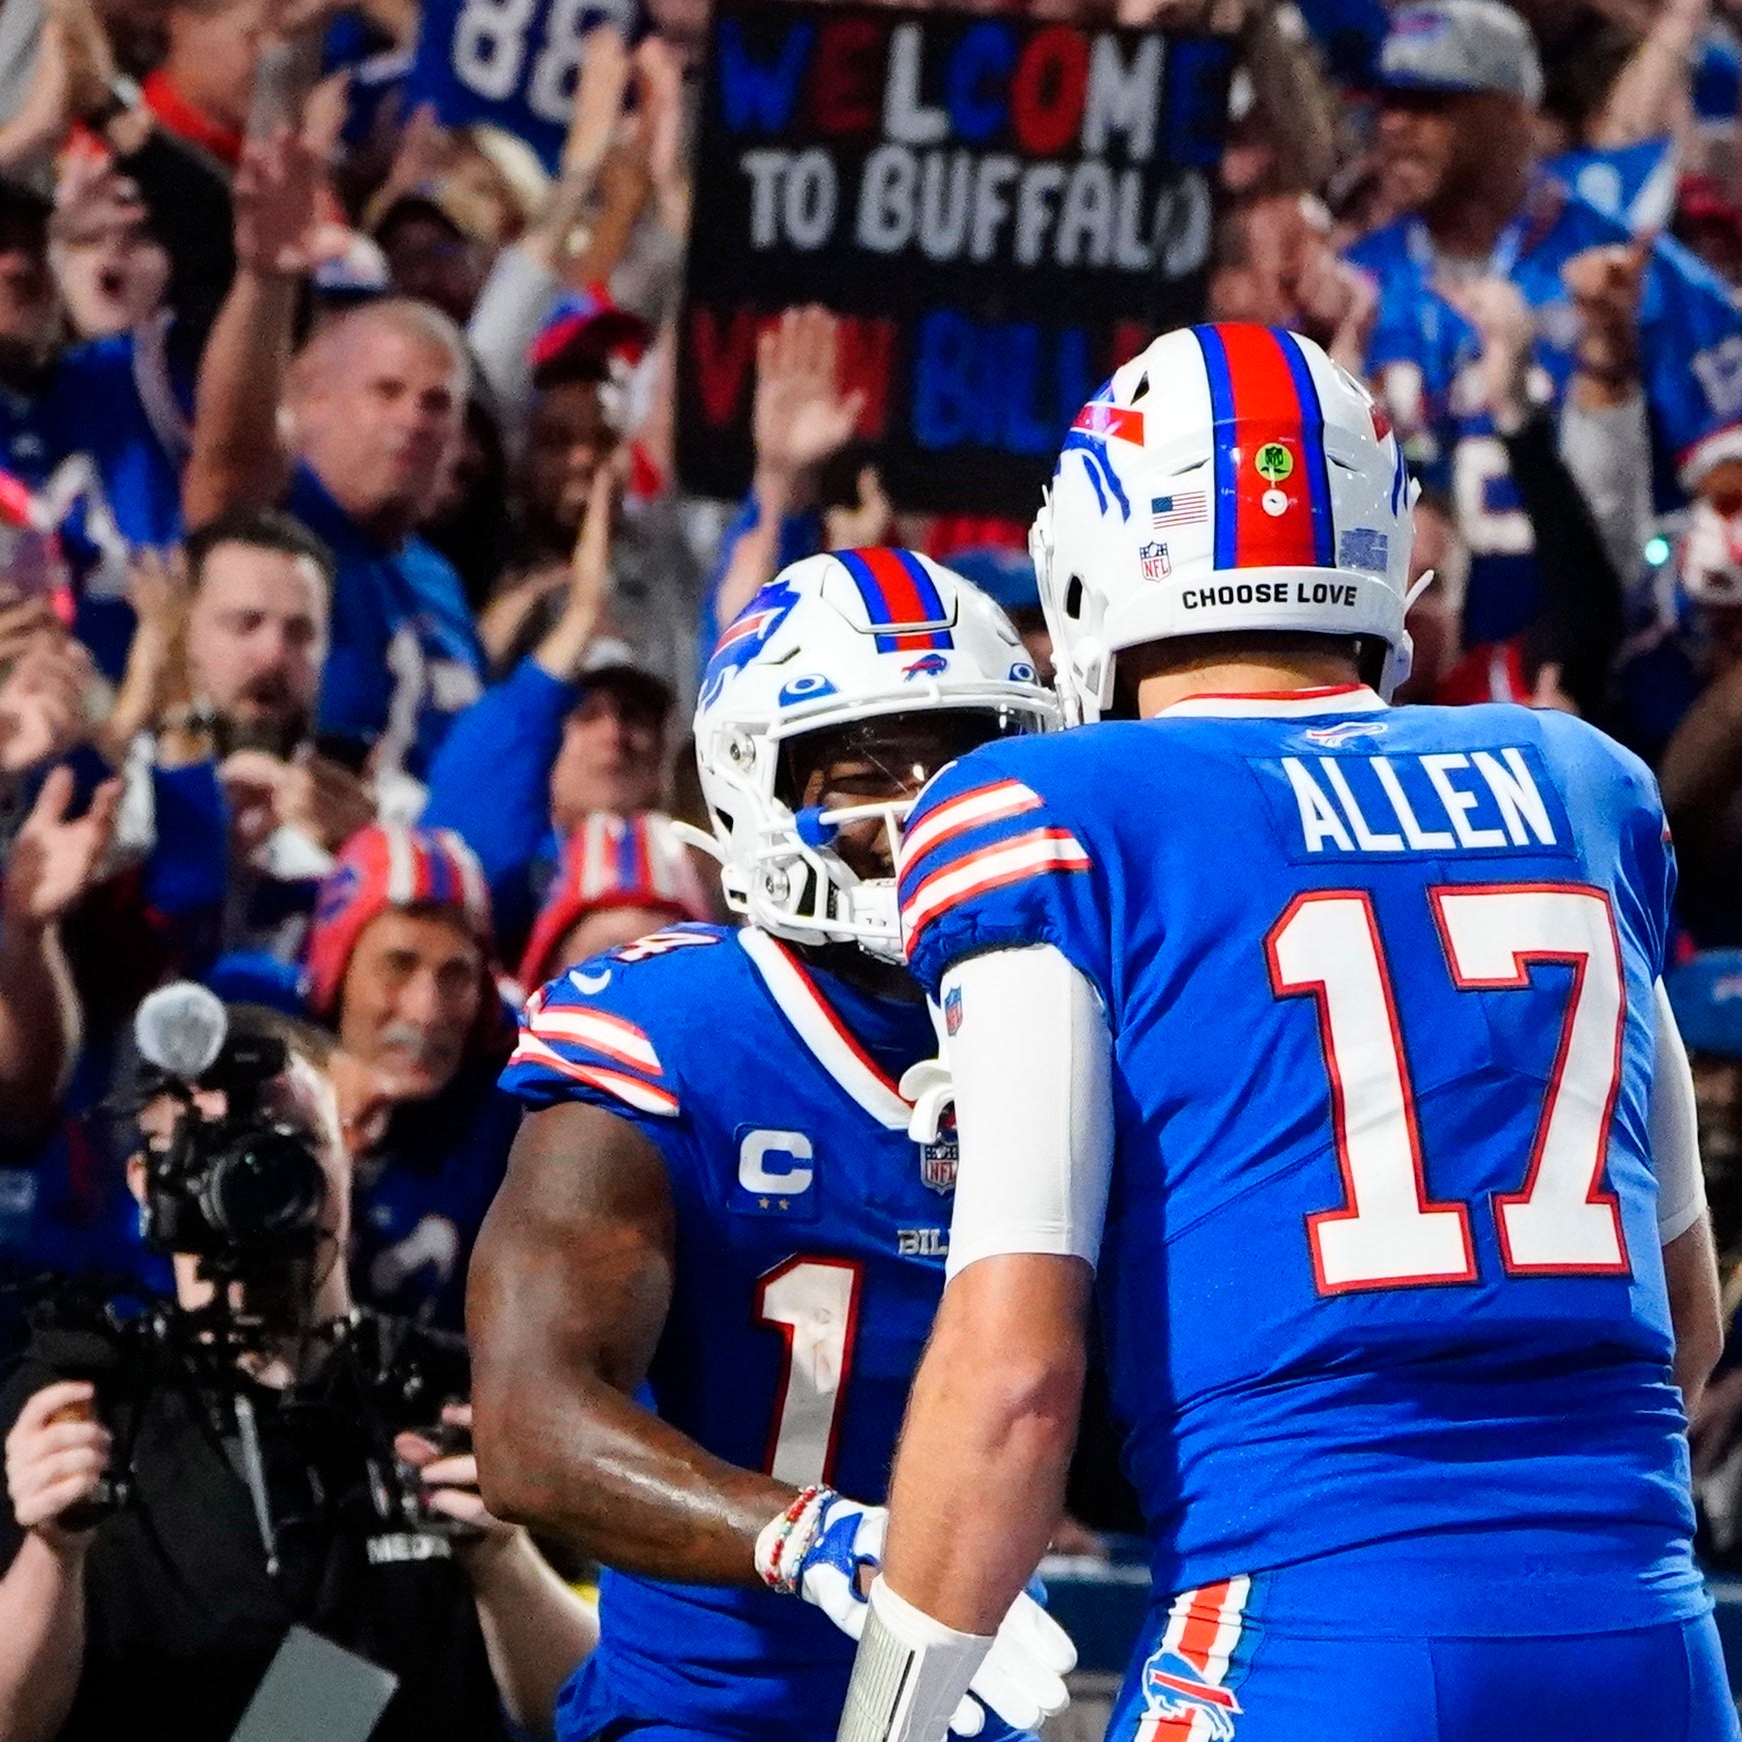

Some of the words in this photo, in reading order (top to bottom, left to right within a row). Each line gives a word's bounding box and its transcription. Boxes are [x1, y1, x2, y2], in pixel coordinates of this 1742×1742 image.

[716, 18, 1236, 166] WELCOME
[740, 146, 839, 251] TO
[854, 145, 1214, 282] BUFFALO
[1182, 583, 1288, 611] CHOOSE
[1297, 582, 1358, 607] LOVE
[1281, 746, 1558, 854] ALLEN
[1264, 881, 1631, 1298] 17
[738, 1129, 814, 1195] C
[928, 1161, 957, 1183] NFL
